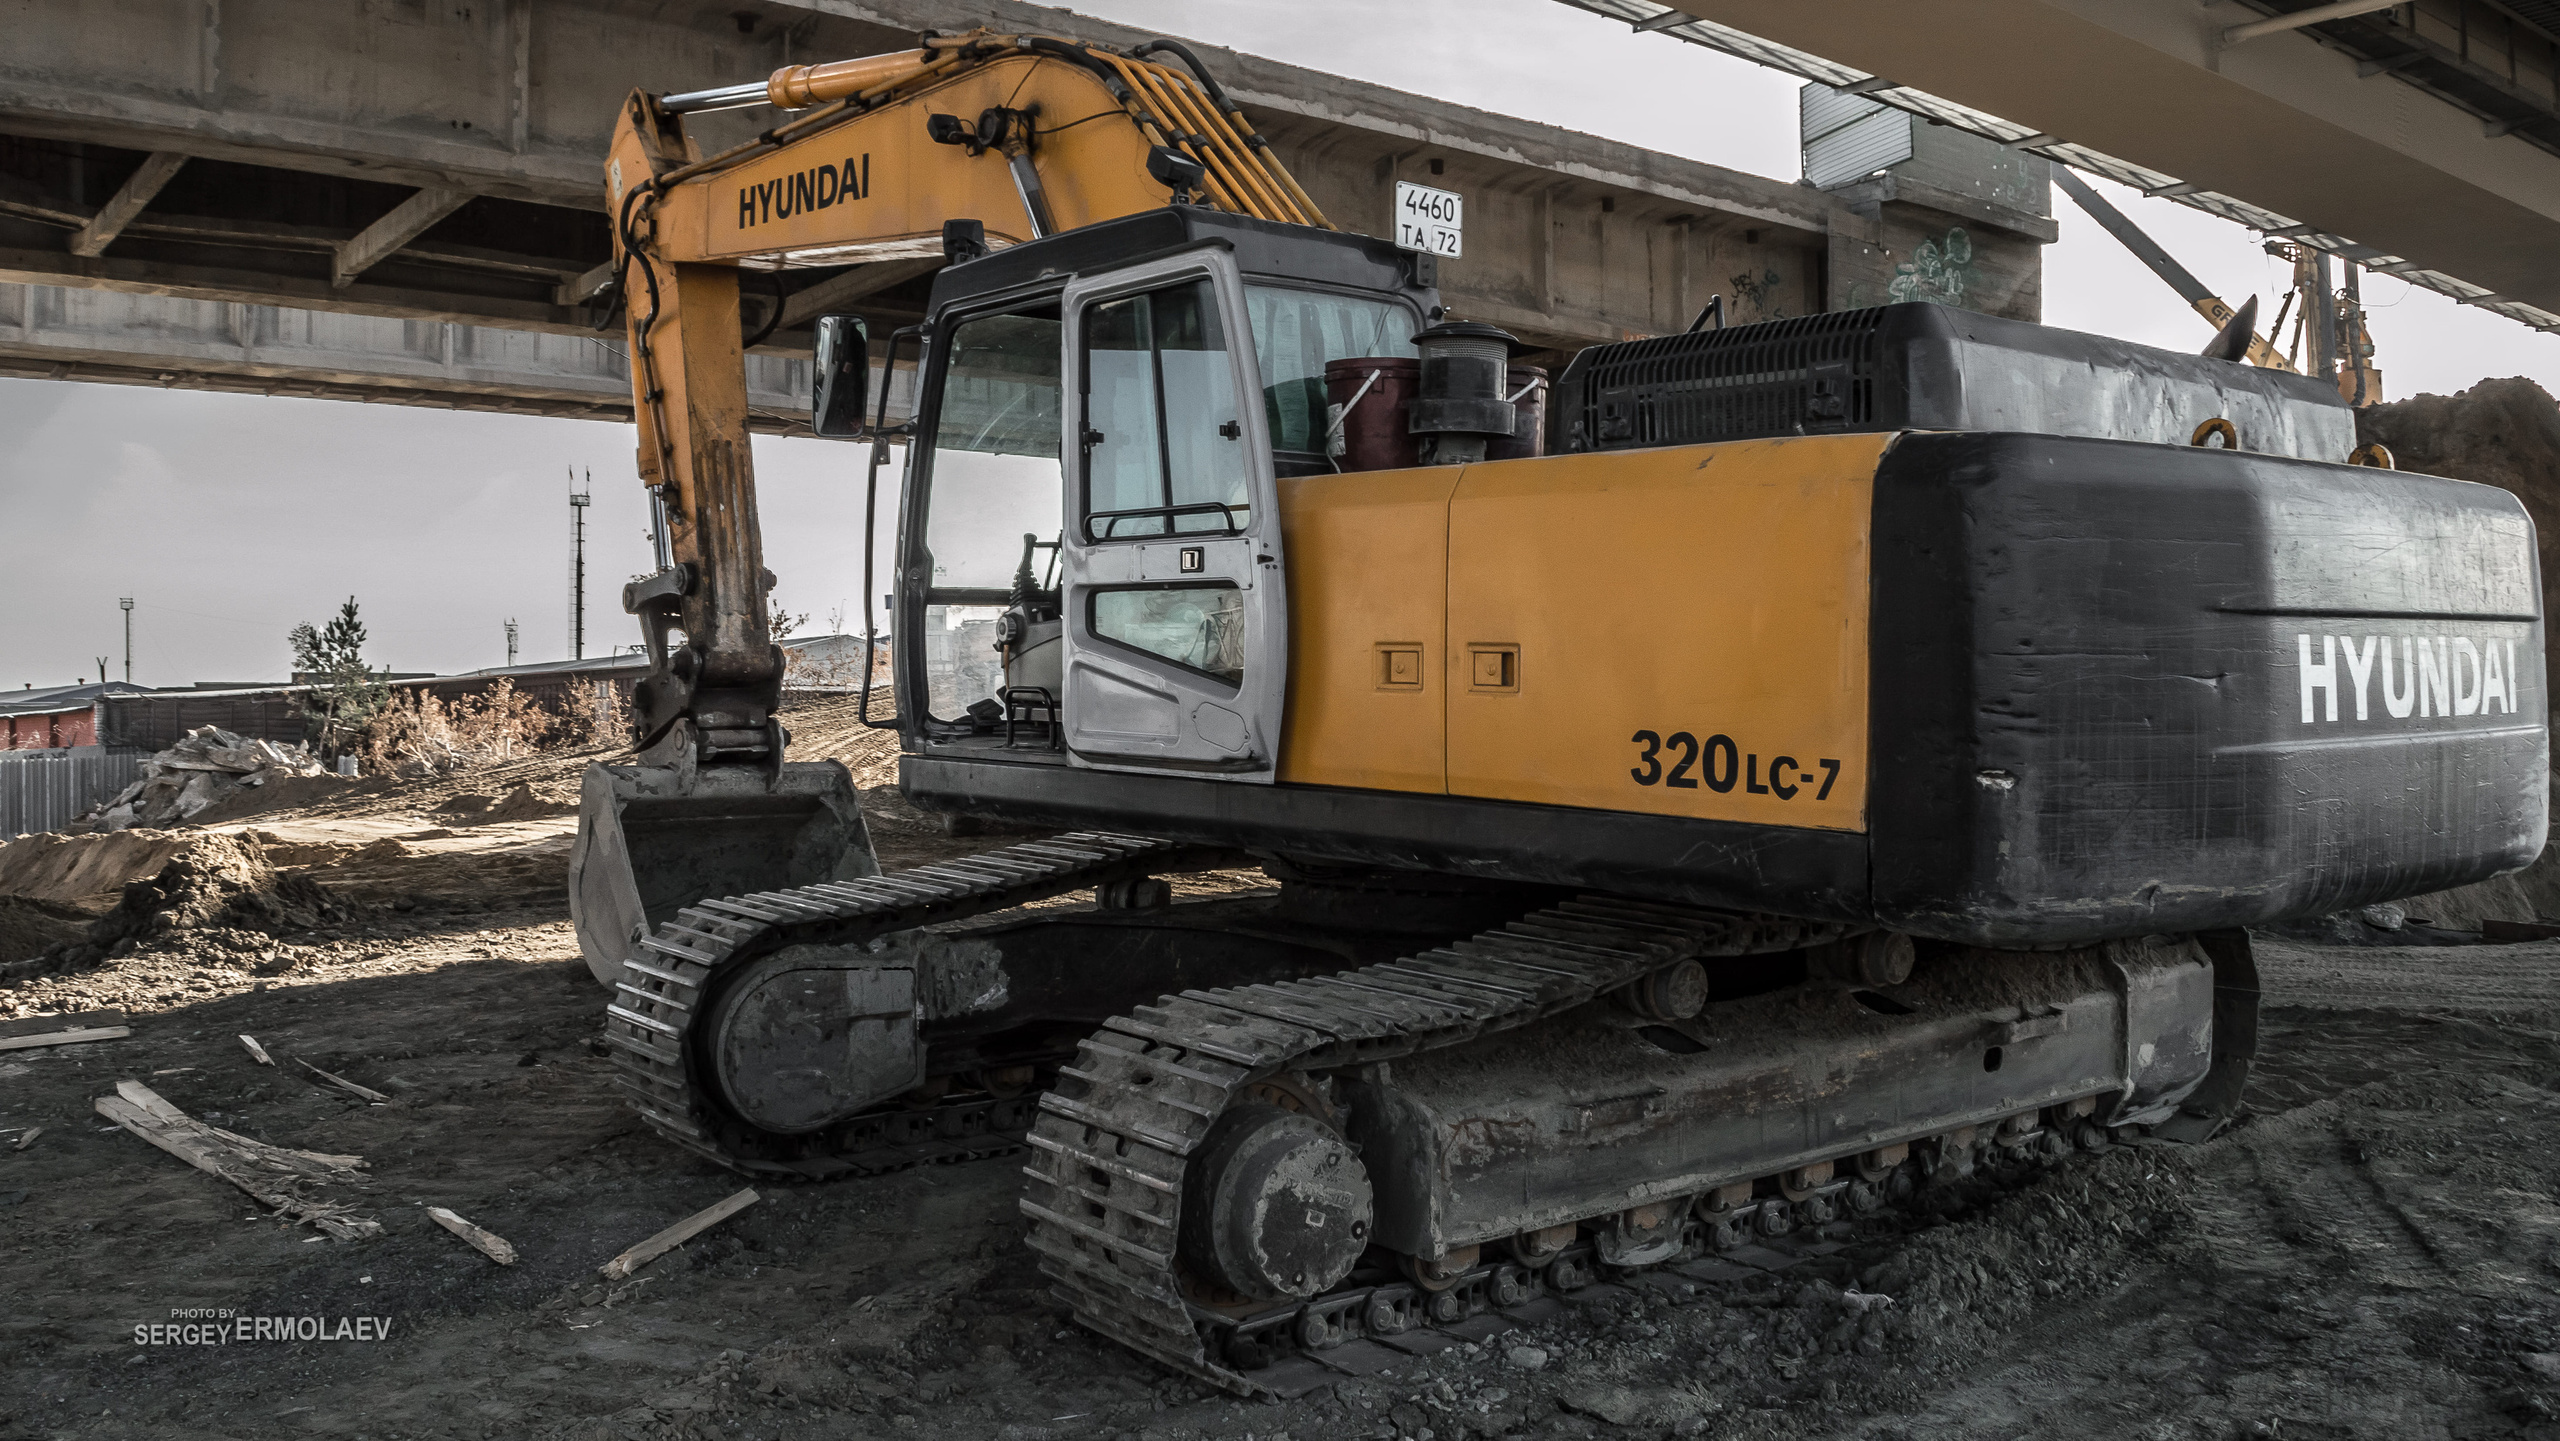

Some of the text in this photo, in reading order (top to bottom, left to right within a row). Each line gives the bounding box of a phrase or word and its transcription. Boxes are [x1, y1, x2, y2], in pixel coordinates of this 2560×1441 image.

[739, 153, 870, 229] HYUNDAI
[1405, 189, 1454, 222] 4460
[1438, 231, 1456, 253] 72
[2298, 634, 2518, 723] HYUNDAI
